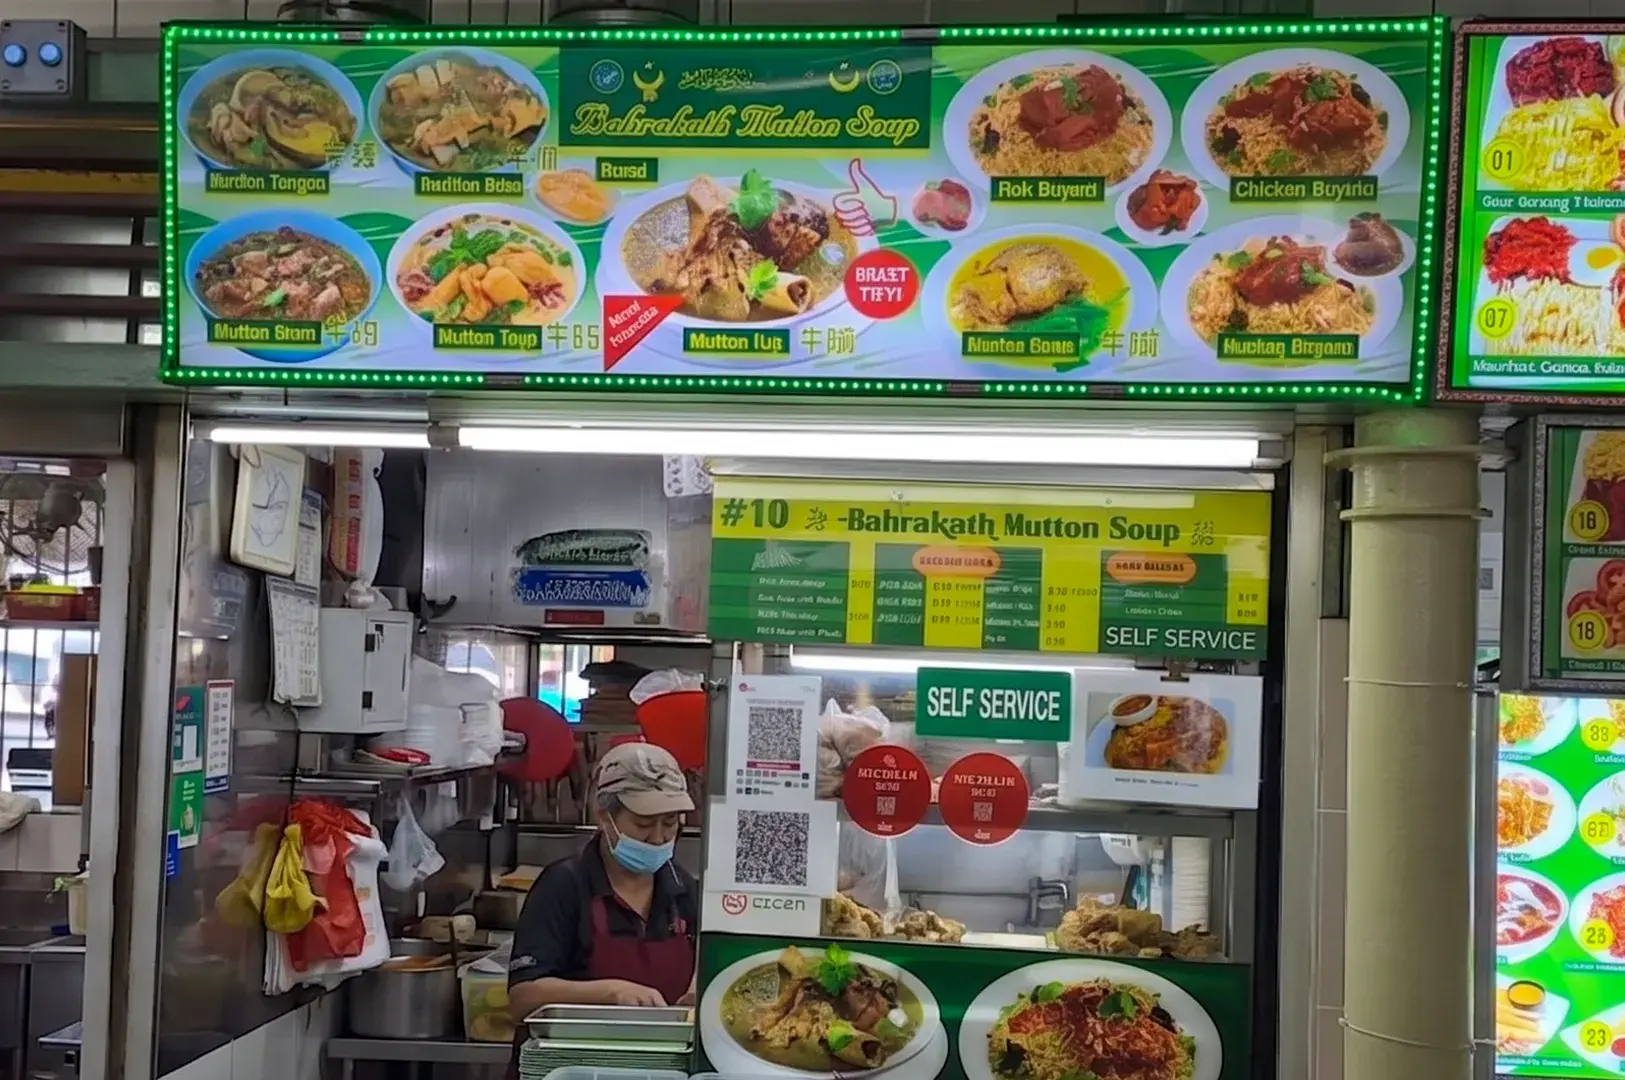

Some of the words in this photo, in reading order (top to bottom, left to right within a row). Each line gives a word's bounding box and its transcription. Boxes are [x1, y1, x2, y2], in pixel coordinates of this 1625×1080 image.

[570, 103, 733, 137] Bahrakath
[736, 105, 842, 137] Mutton
[846, 105, 920, 146] Soup
[1492, 150, 1513, 171] 01
[999, 181, 1034, 198] Rok
[1235, 180, 1306, 198] Chicken
[1485, 307, 1508, 329] 07
[214, 323, 270, 341] Mutton
[438, 327, 495, 346] Mutton
[689, 332, 749, 350] Mutton
[720, 498, 789, 529] #10
[1004, 512, 1099, 540] Mutton
[1109, 515, 1181, 547] Soup
[1106, 626, 1158, 646] SELF
[1164, 628, 1256, 650] SERVICE
[1577, 621, 1595, 640] 18
[927, 686, 975, 717] SELF
[979, 688, 1061, 721] SERVICE
[1586, 1029, 1607, 1046] 23
